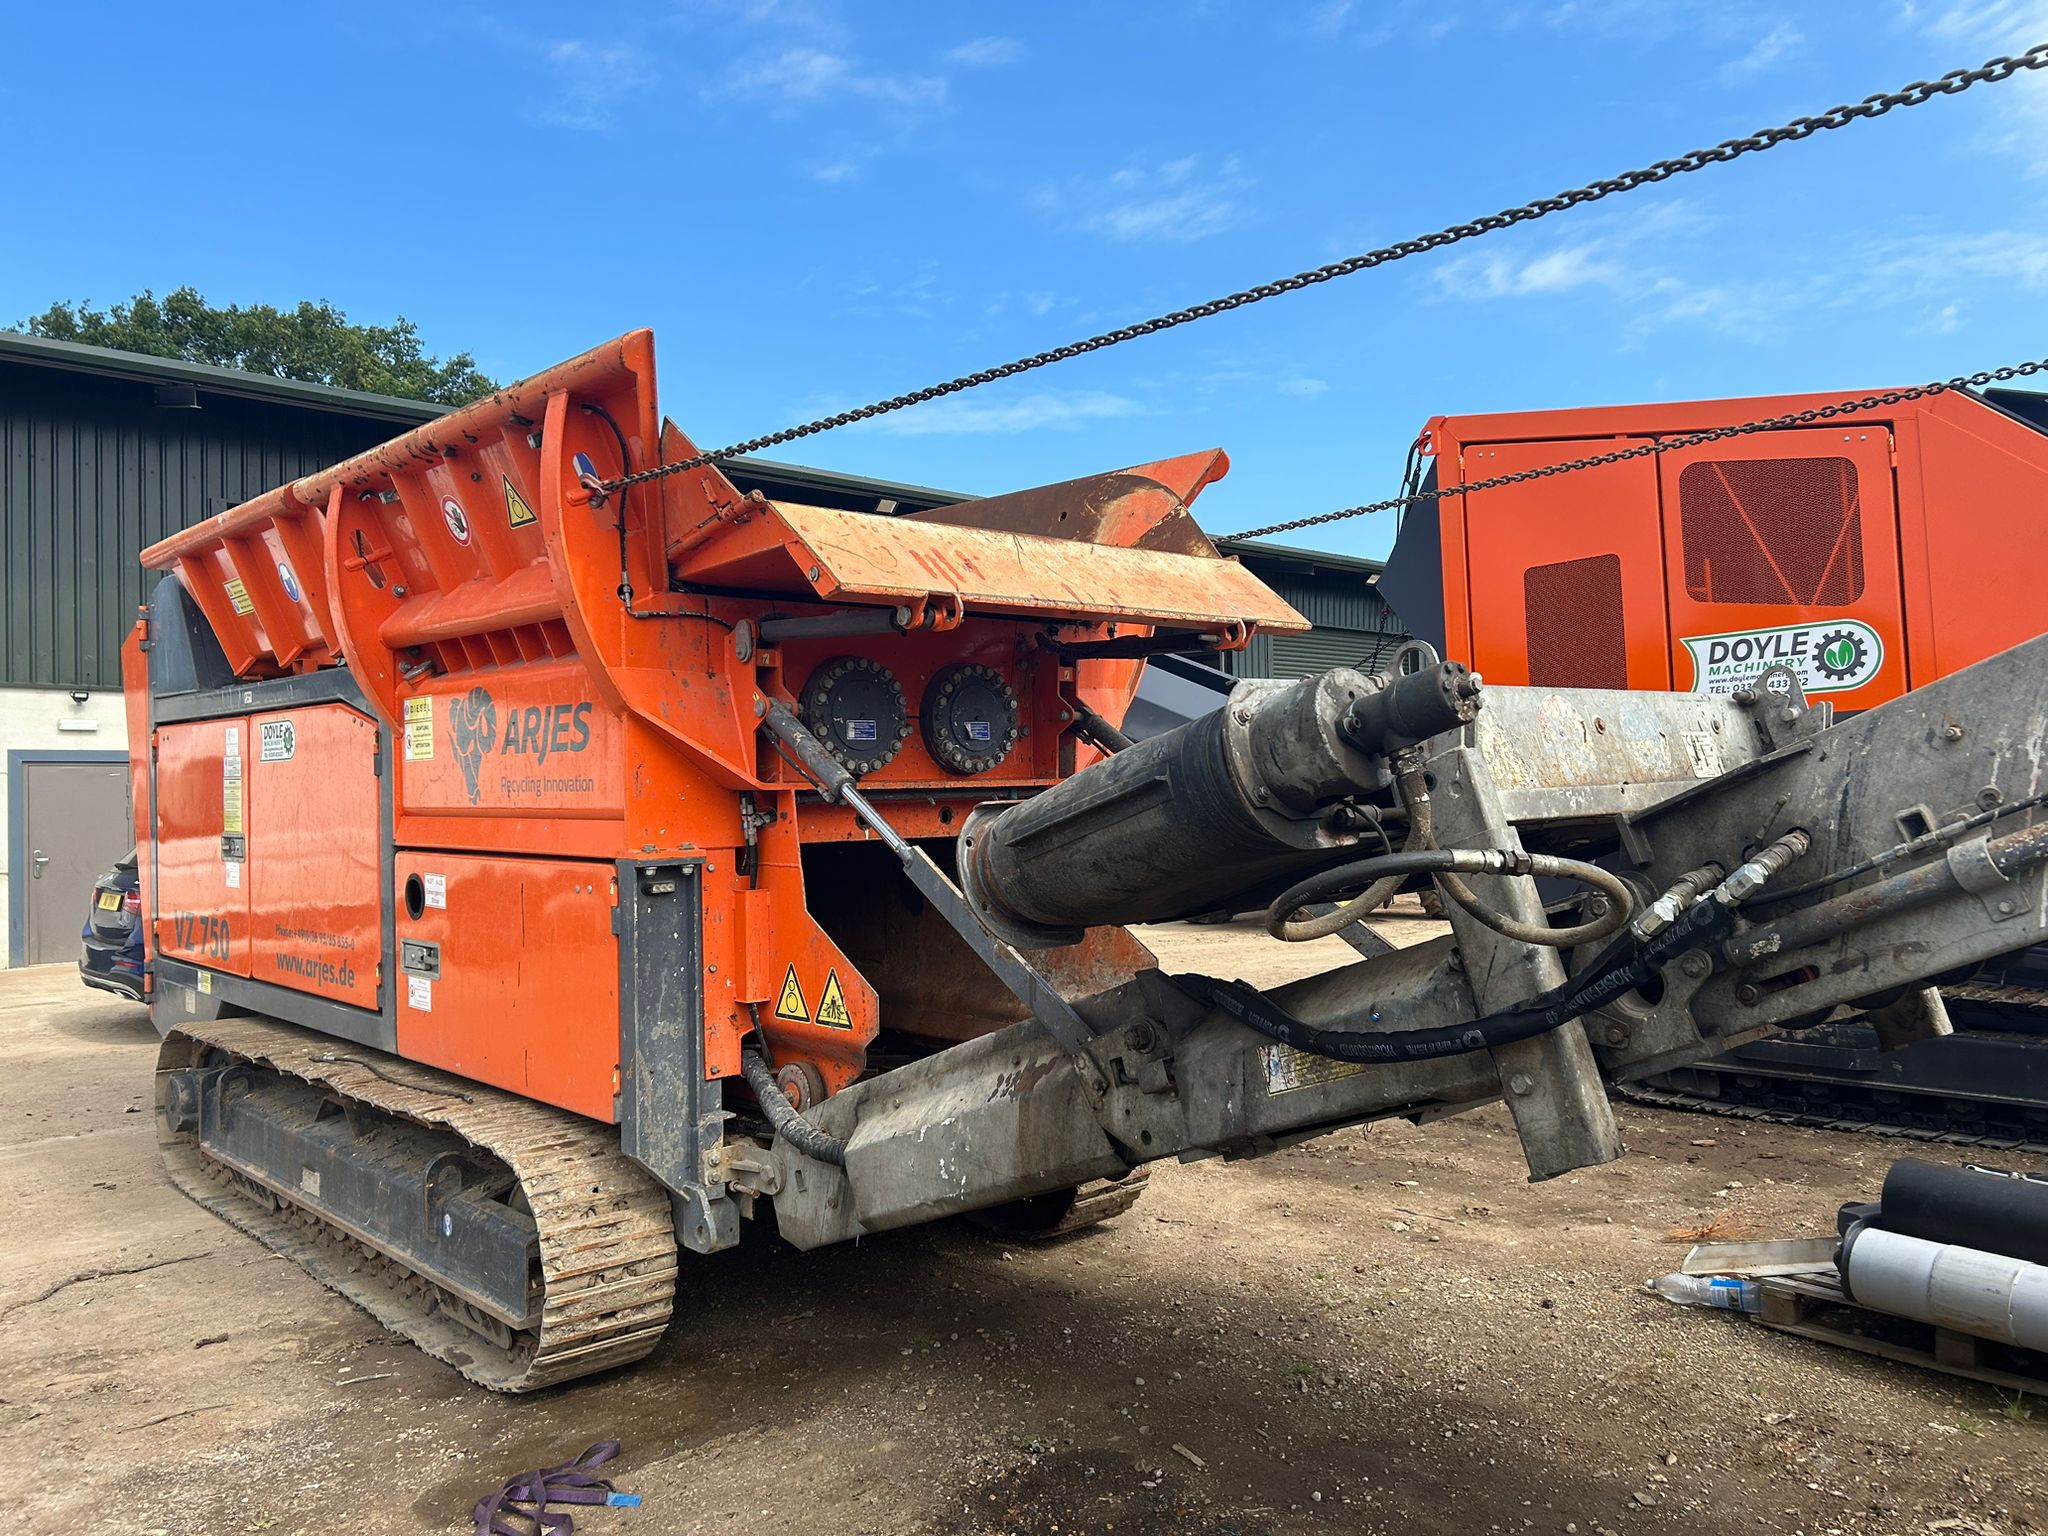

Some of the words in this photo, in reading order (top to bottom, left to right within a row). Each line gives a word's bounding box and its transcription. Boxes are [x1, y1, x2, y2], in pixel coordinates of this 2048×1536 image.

[1708, 631, 1810, 665] DOYLE
[1710, 686, 1730, 694] TEL:
[410, 703, 430, 714] DIESEL
[264, 724, 283, 740] DOYLE
[501, 702, 593, 766] ARJES
[501, 776, 542, 797] Recycling
[543, 774, 594, 793] Innovation
[174, 909, 195, 952] VZ
[200, 916, 230, 961] 750
[276, 952, 355, 988] www.arjes.de
